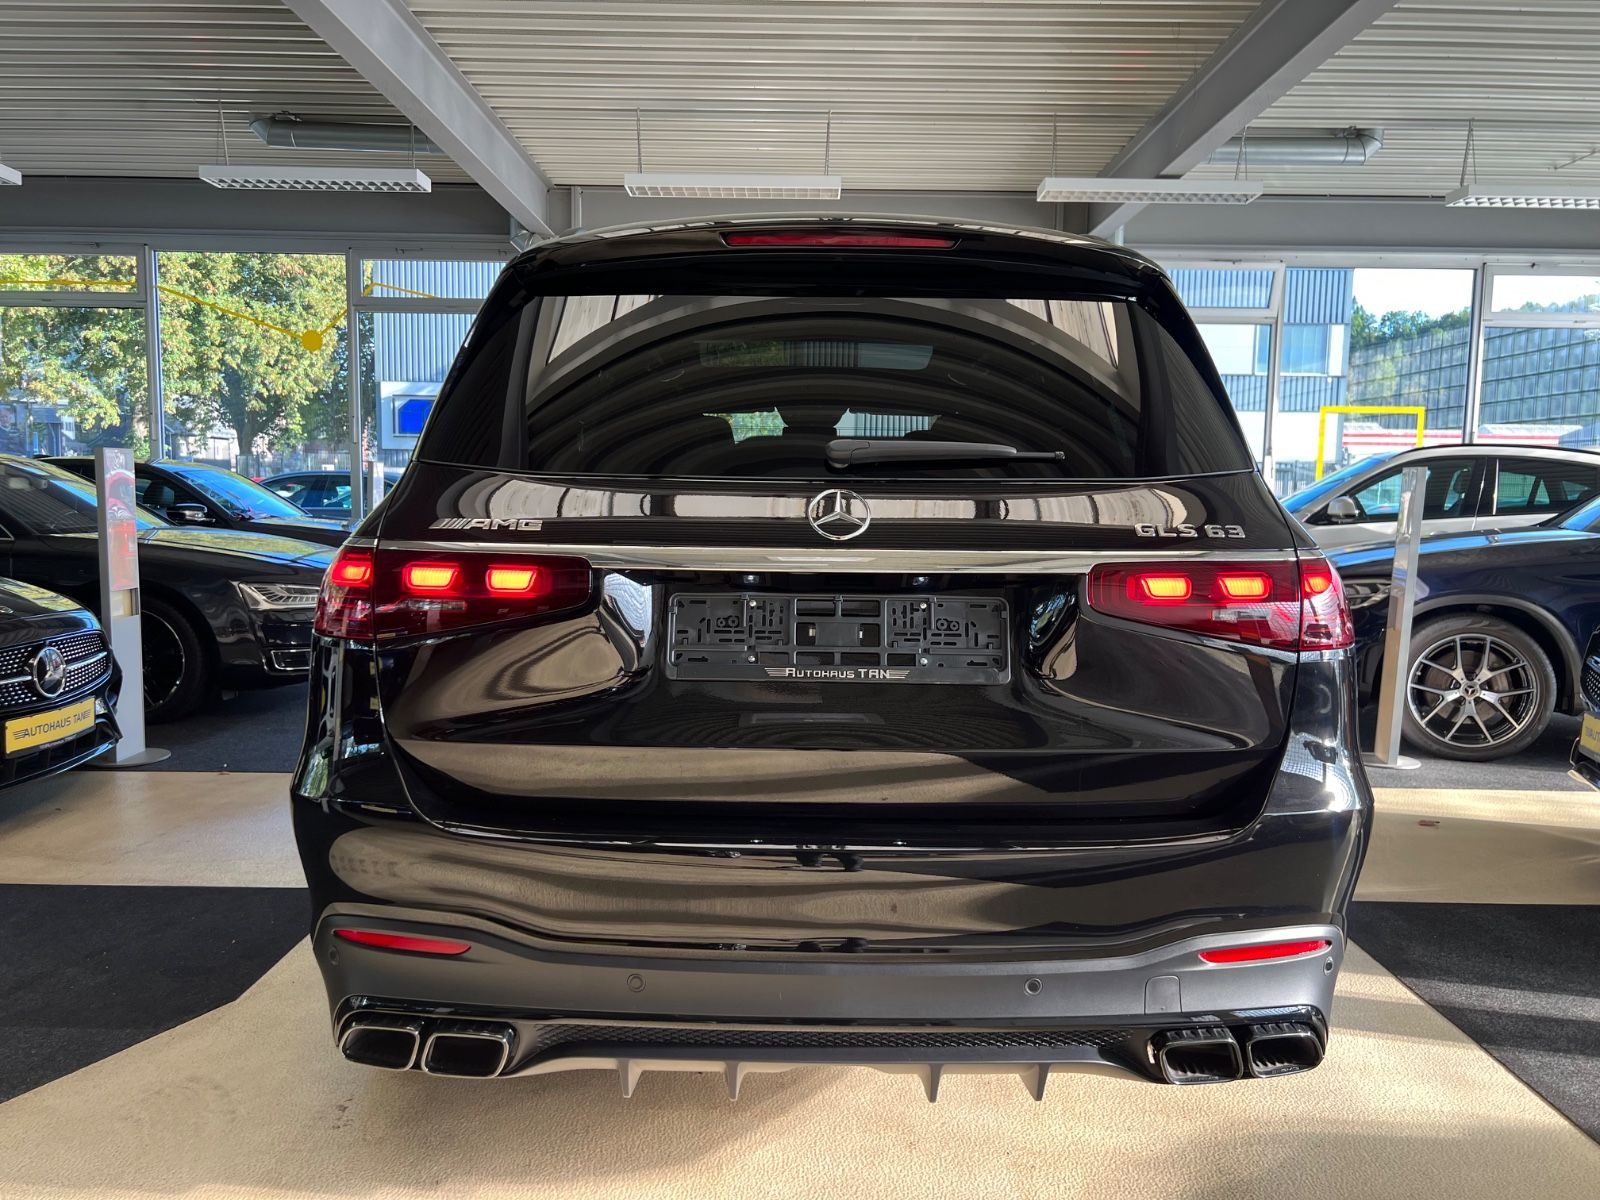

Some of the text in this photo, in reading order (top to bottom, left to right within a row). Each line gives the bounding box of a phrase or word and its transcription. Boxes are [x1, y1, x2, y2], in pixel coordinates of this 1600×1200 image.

[463, 518, 543, 531] AMG
[1134, 523, 1246, 538] GLS 63
[785, 667, 890, 680] AUTOHAUS TAN
[24, 712, 87, 737] AUTOHAUS TAN
